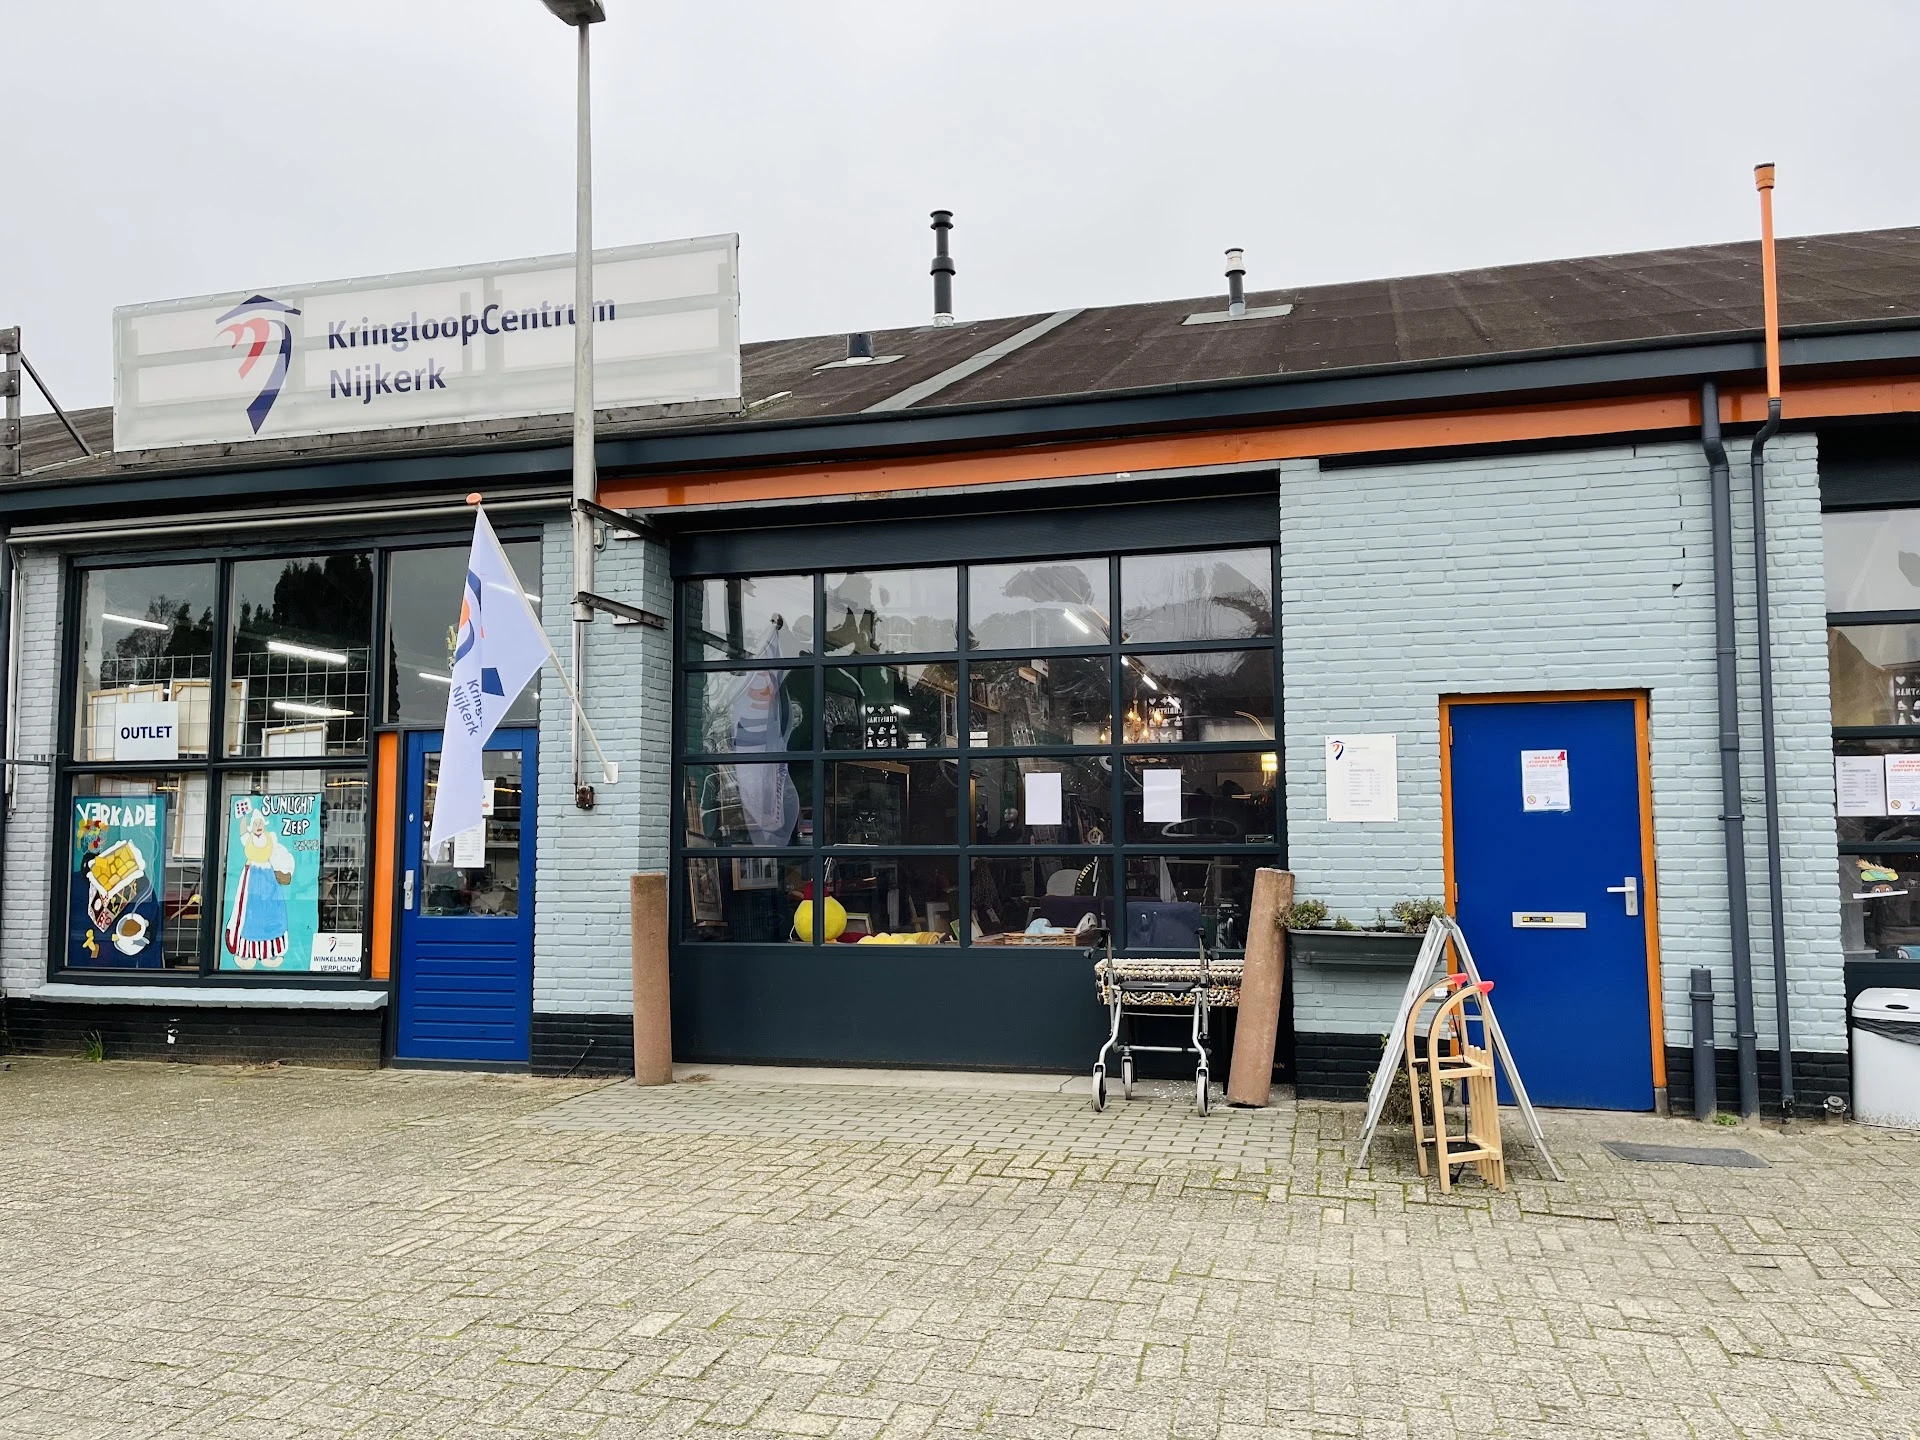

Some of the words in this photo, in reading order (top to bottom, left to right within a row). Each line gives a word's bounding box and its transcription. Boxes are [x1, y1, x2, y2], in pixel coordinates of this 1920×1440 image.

[330, 358, 447, 404] Nijkerk
[453, 686, 479, 736] Nijkerk
[120, 725, 173, 740] OUTLET
[76, 802, 156, 827] VERKADE
[261, 795, 316, 817] SUNLIGHT
[281, 818, 310, 836] ZEEP
